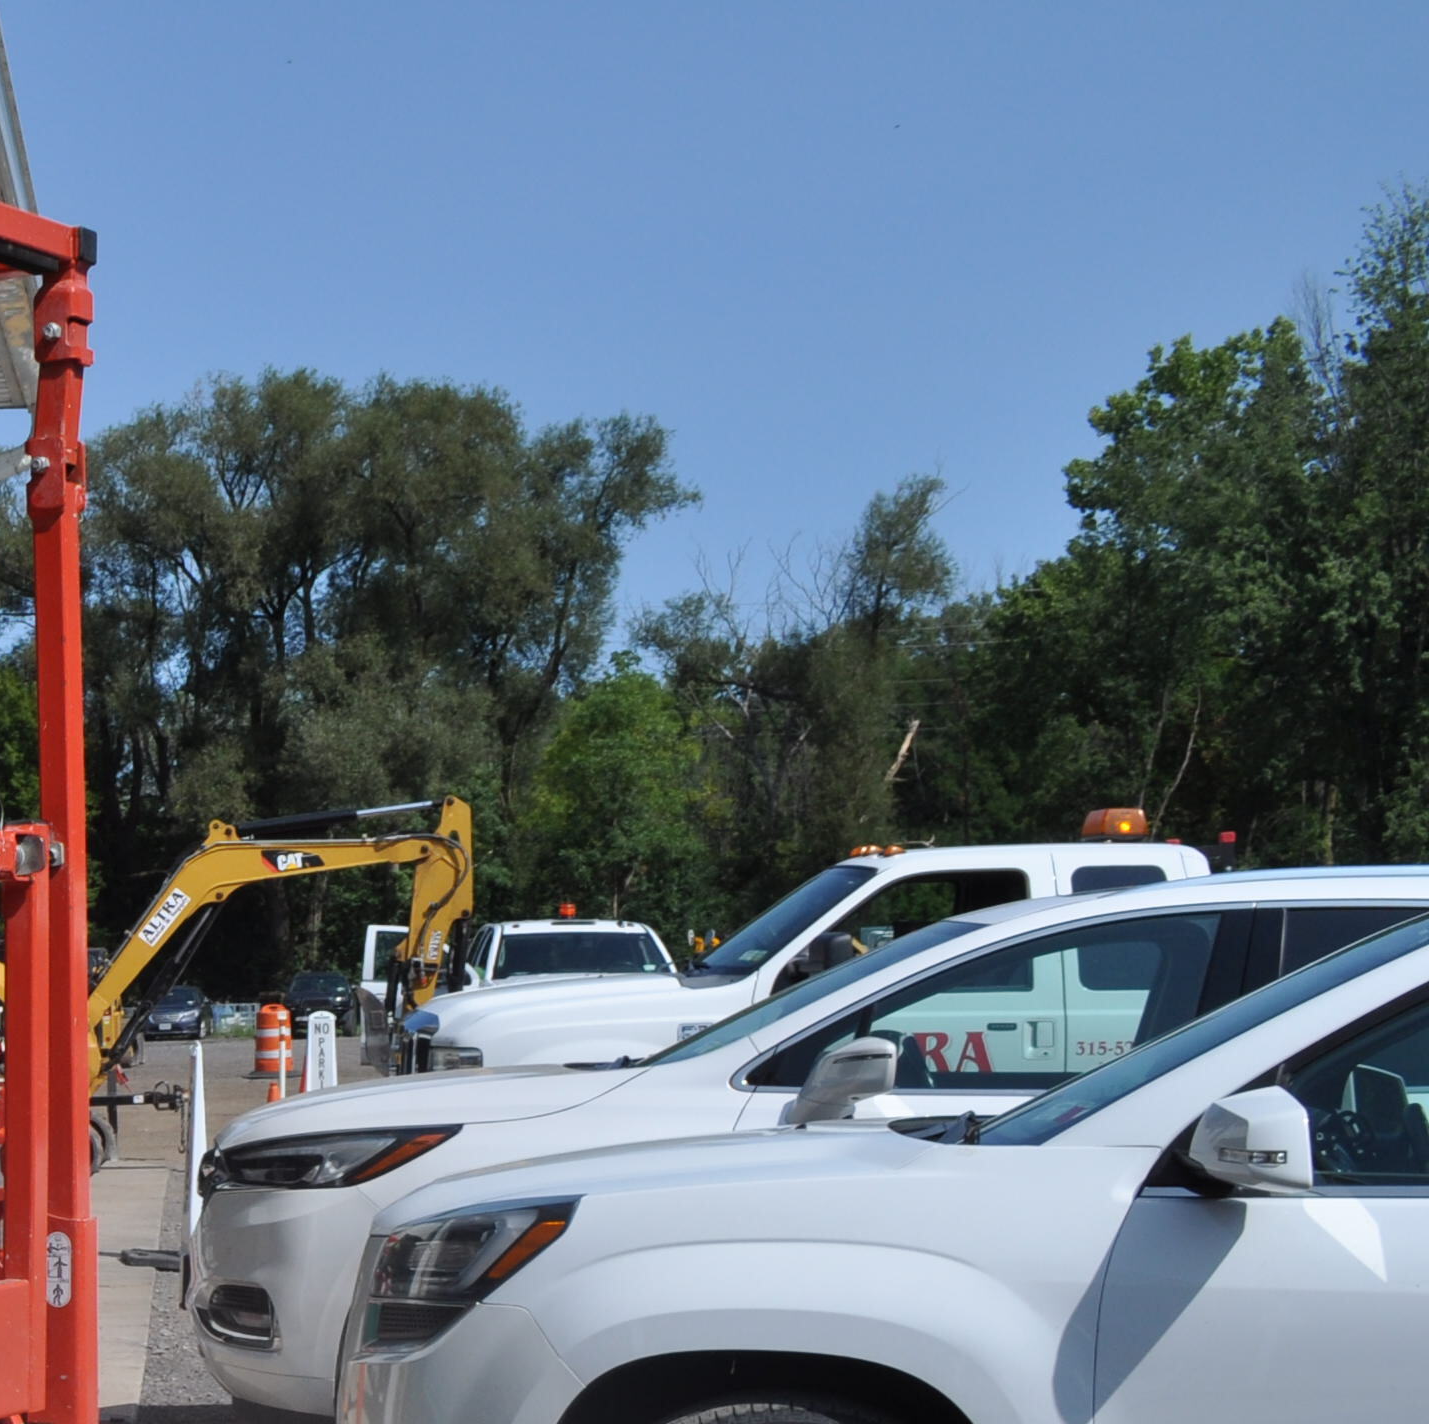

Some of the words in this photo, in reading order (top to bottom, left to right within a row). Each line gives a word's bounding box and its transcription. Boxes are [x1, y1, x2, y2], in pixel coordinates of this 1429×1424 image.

[277, 853, 303, 872] CAT
[142, 891, 185, 941] ALTRA
[314, 1023, 330, 1035] NO
